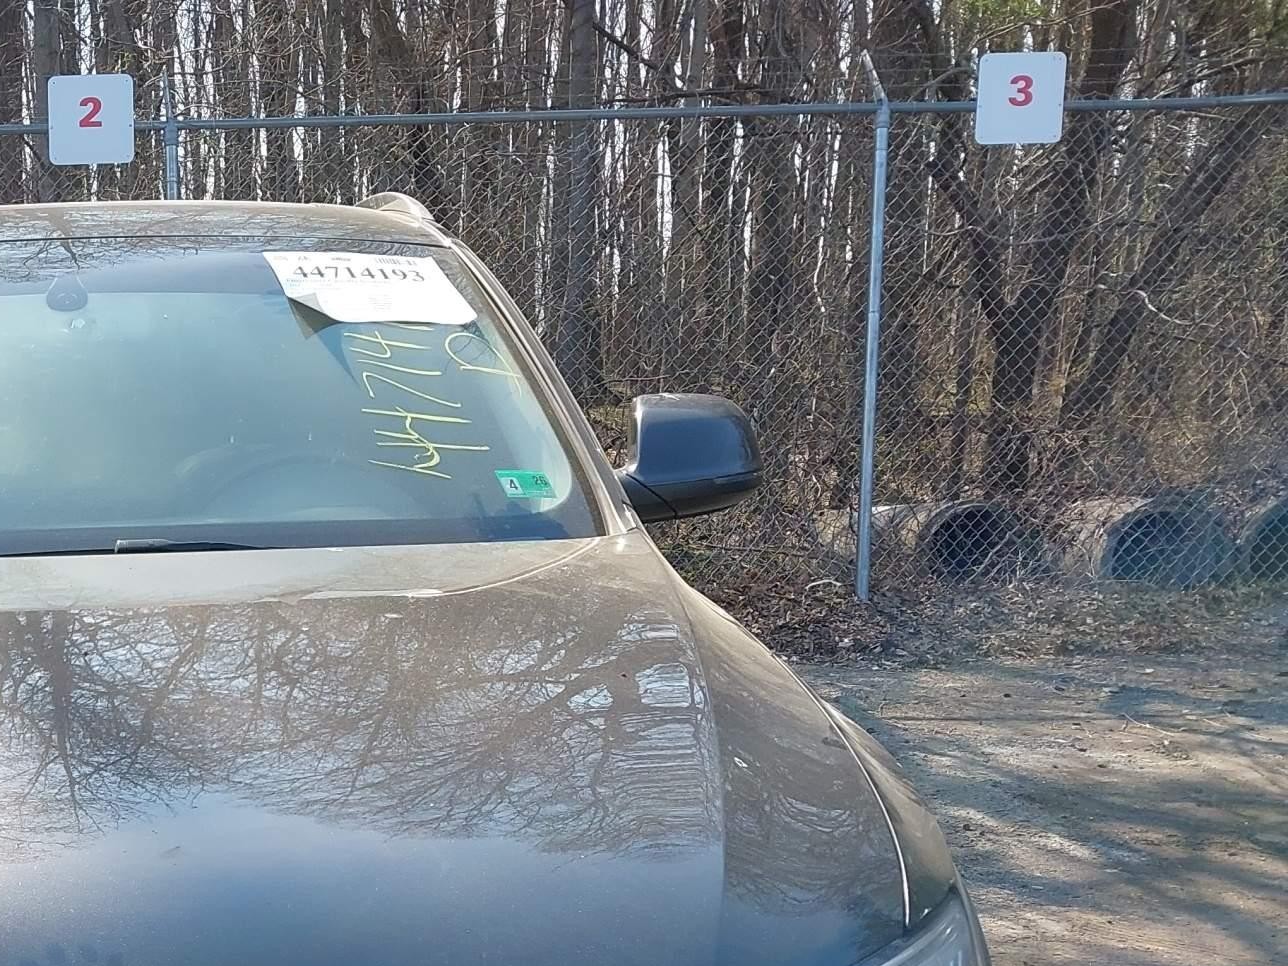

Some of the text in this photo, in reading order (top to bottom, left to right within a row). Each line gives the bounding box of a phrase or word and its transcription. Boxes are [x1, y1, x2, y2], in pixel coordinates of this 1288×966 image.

[1008, 75, 1033, 107] 3
[79, 97, 103, 128] 2
[292, 265, 426, 282] 44714193
[509, 479, 518, 491] 4
